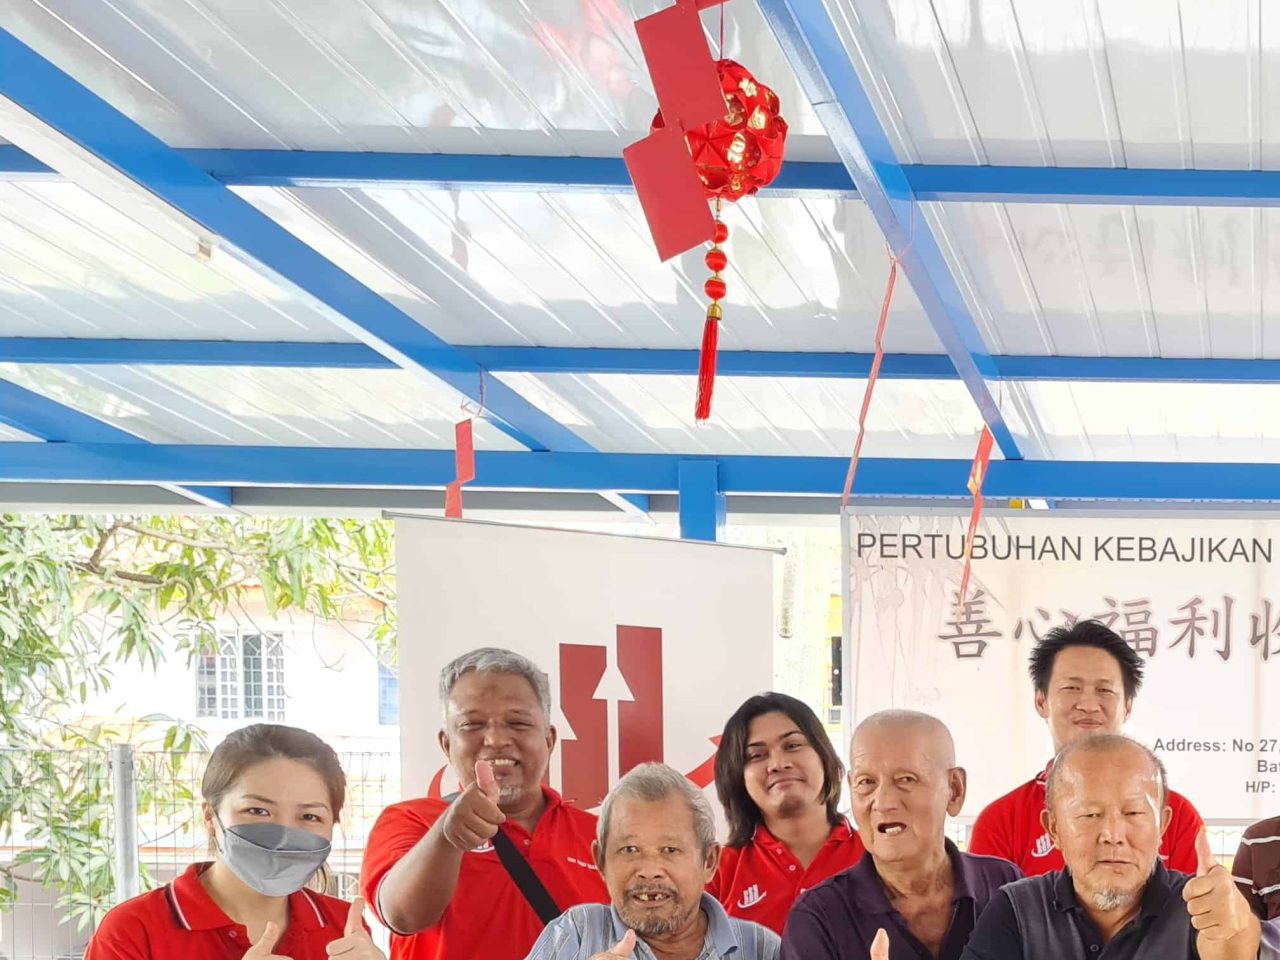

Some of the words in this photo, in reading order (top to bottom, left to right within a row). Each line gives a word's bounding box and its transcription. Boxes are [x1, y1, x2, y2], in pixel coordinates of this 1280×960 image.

[857, 533, 1082, 561] PERTUBUHAN
[1094, 536, 1273, 563] KEBAJIKAN
[1154, 738, 1226, 752] Address:
[1232, 739, 1254, 752] No
[1245, 781, 1276, 793] H/P:
